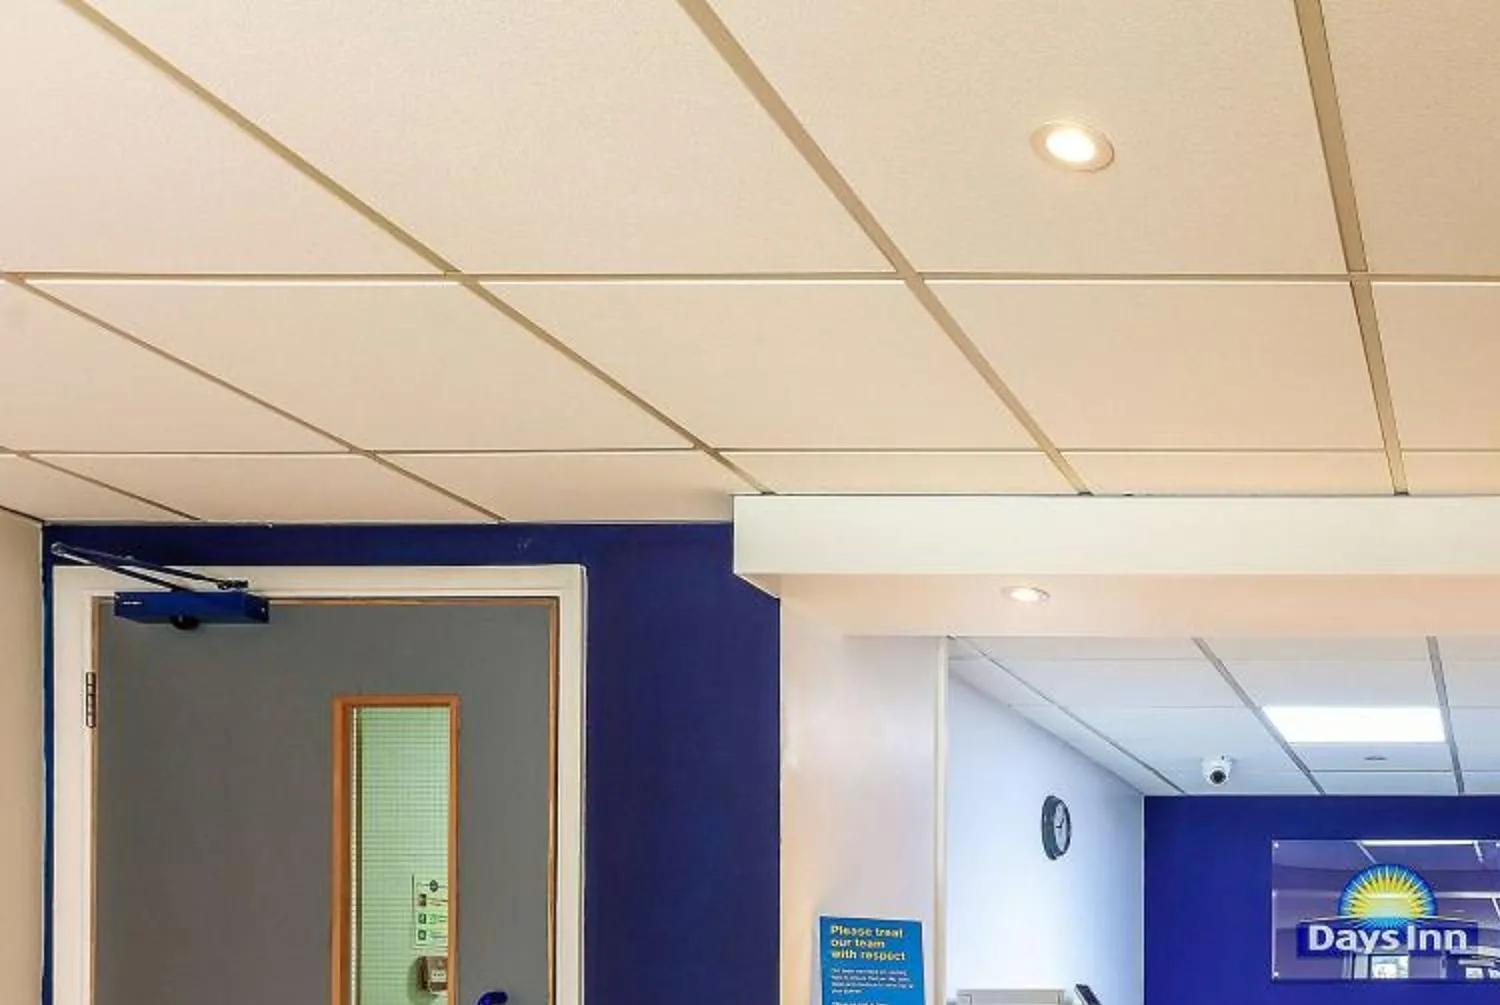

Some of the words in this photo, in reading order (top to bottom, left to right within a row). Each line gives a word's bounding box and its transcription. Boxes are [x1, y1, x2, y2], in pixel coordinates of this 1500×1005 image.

[831, 925, 872, 936] Please
[875, 928, 903, 938] treat
[831, 939, 852, 948] our
[855, 939, 885, 948] team
[1308, 924, 1400, 954] Days
[1407, 924, 1467, 951] Inn
[831, 949, 857, 960] with
[861, 951, 905, 961] respect
